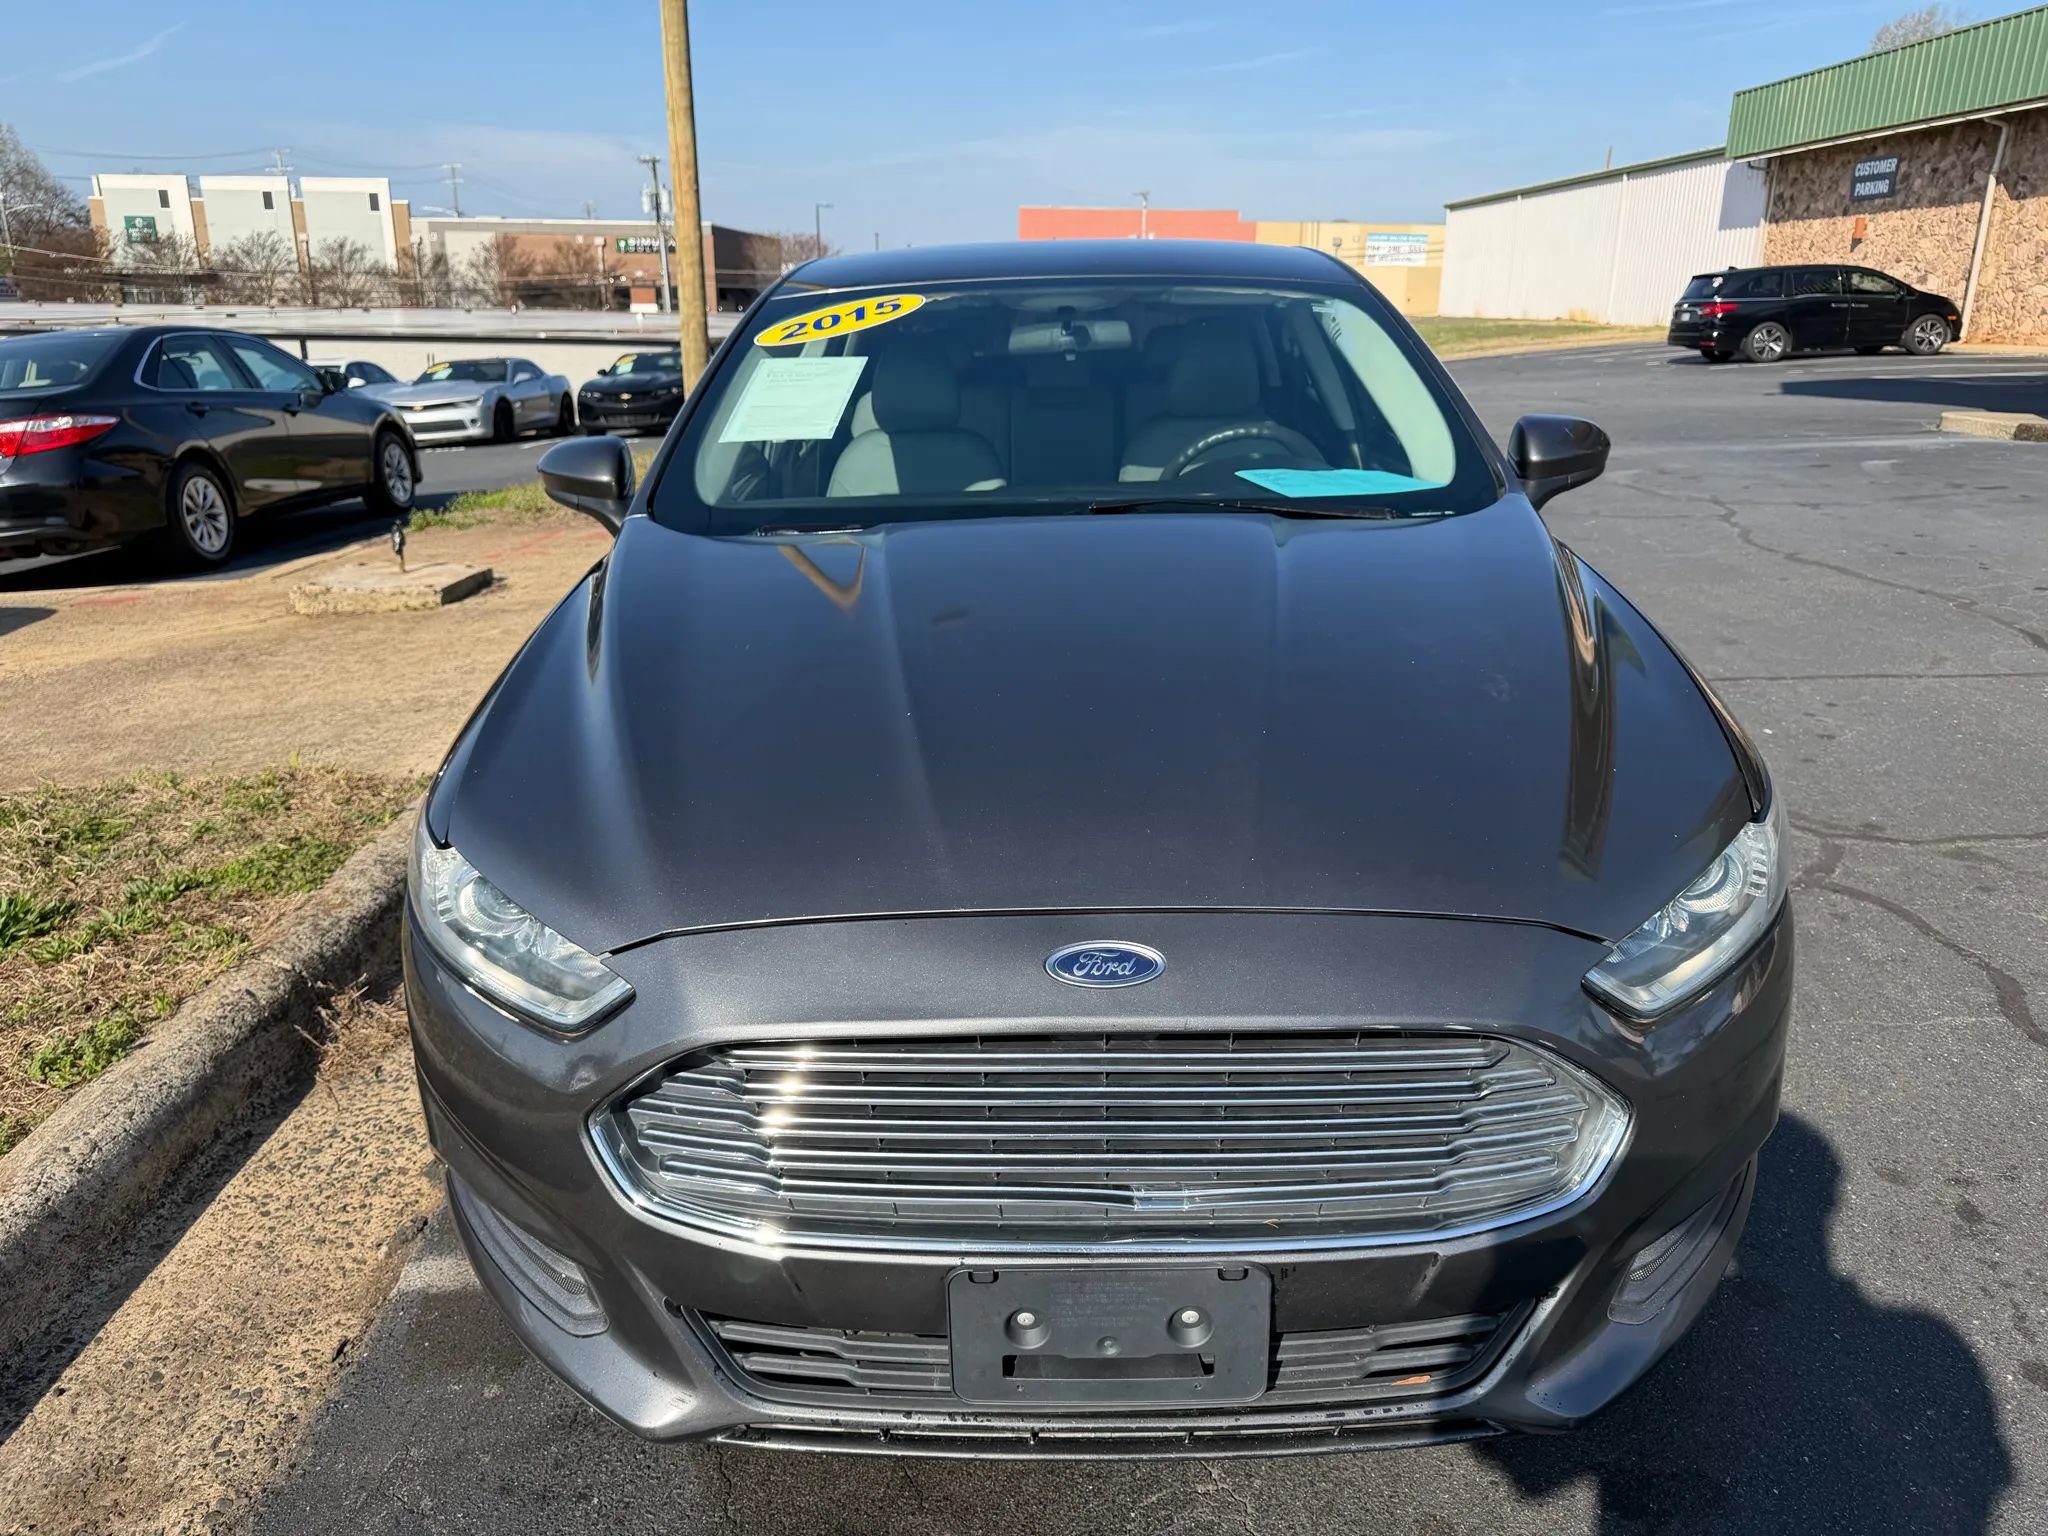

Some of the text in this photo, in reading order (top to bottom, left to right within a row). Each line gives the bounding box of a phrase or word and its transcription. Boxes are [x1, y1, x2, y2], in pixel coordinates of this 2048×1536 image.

[1855, 158, 1898, 177] CUSTOMER
[1854, 179, 1889, 196] PARKING
[778, 298, 902, 342] 2015
[1072, 951, 1137, 976] Ford
